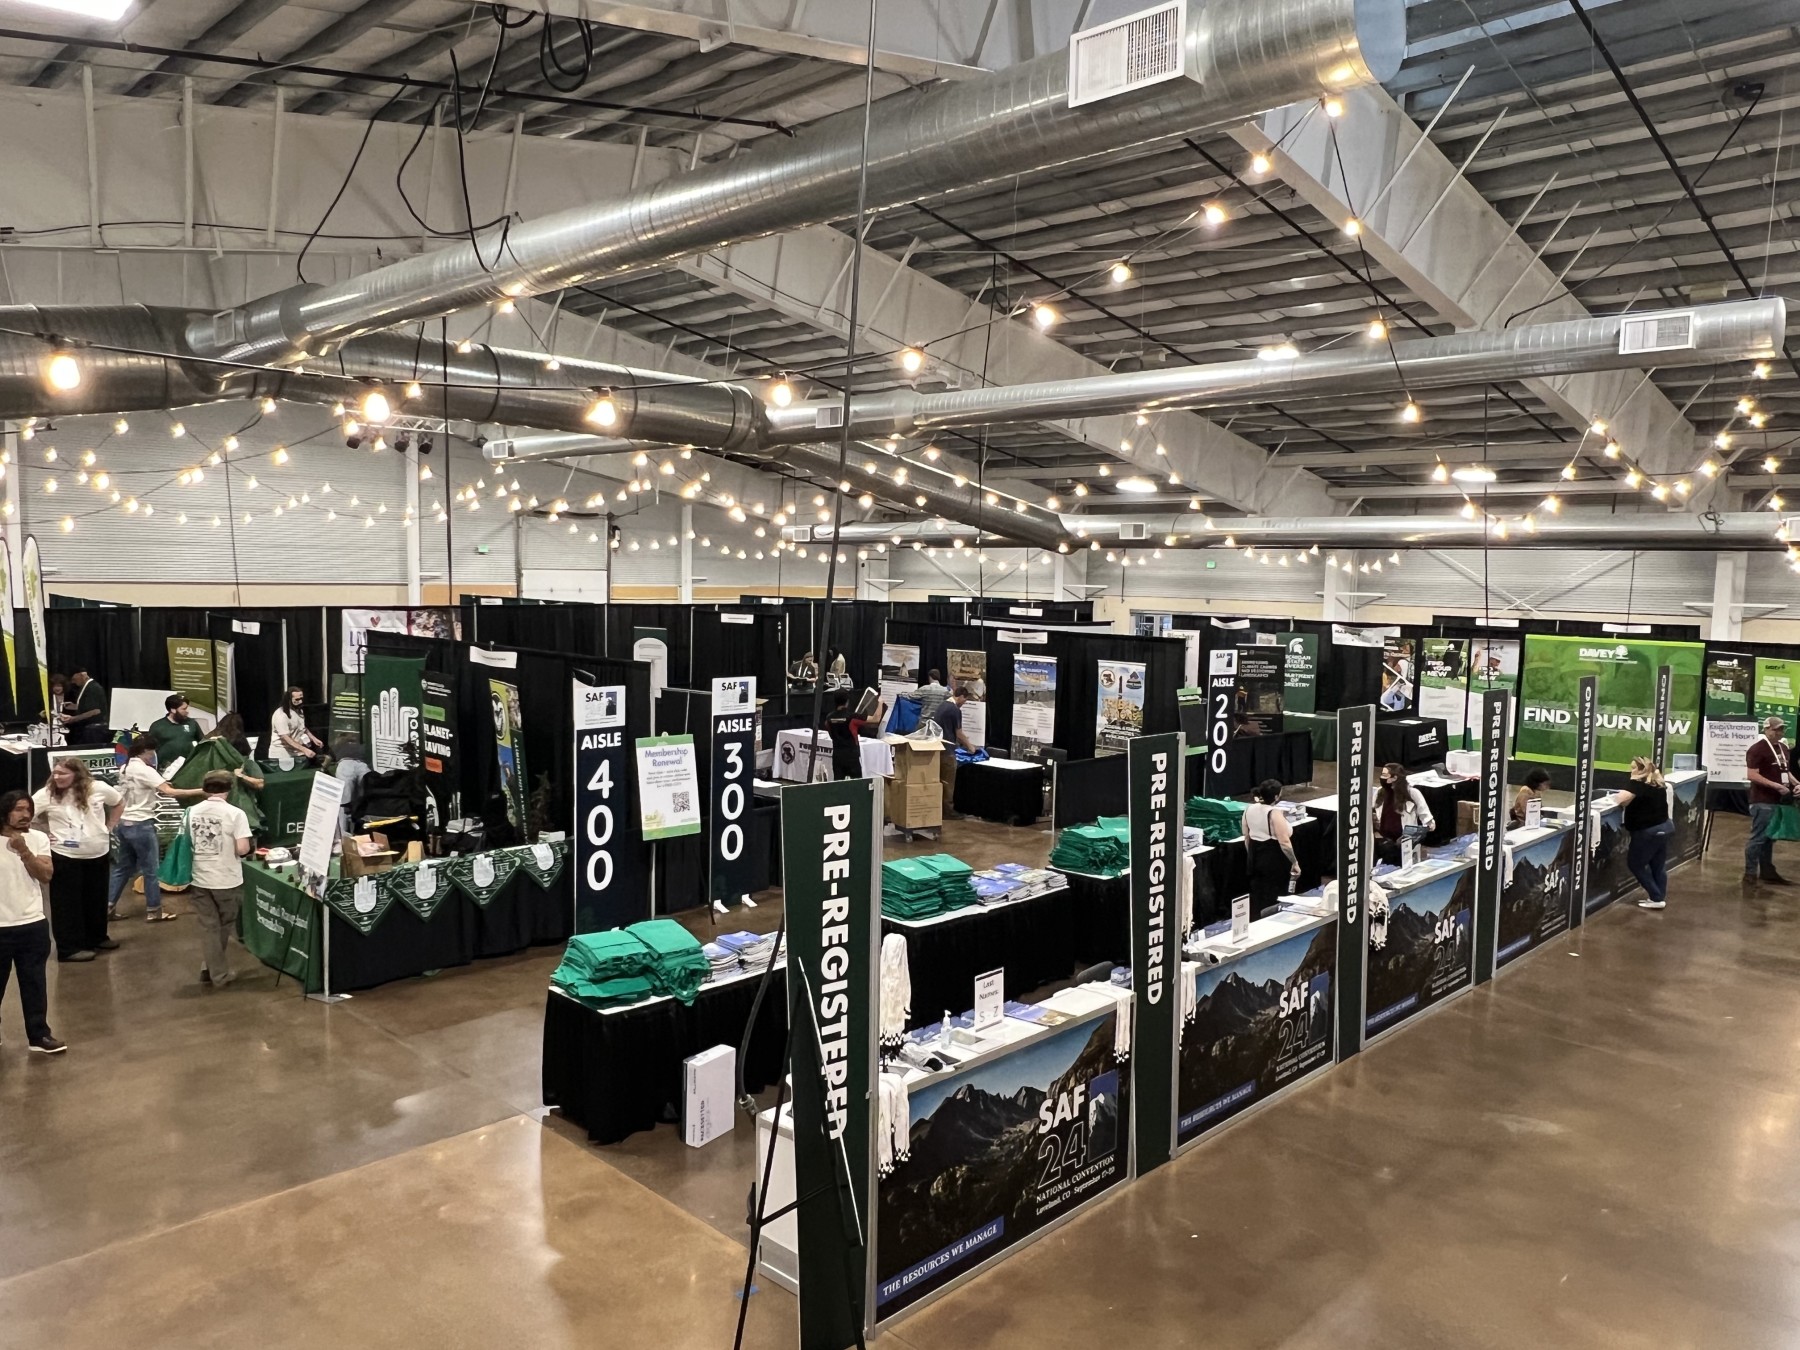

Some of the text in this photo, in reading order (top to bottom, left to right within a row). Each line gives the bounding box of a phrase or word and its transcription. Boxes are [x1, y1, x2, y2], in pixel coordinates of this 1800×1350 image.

[1580, 648, 1615, 658] DAVEY
[722, 682, 737, 690] SAF
[1212, 678, 1234, 687] AISLE
[585, 692, 604, 702] SAF
[716, 718, 752, 734] AISLE
[1524, 707, 1570, 724] FIND
[1709, 722, 1756, 732] Registration
[581, 732, 622, 750] AISLE
[1212, 694, 1228, 773] 200
[1710, 731, 1755, 740] Desk Hours
[645, 748, 688, 758] Membership
[652, 758, 682, 766] Renewal
[1485, 702, 1502, 871] PRE-REGISTERED
[1574, 686, 1592, 890] ONSITE REGISTRATION
[720, 742, 744, 860] 300
[586, 759, 614, 890] 400
[1346, 720, 1362, 924] PRE-REGISTERED
[1148, 752, 1168, 1005] PRE-REGISTERED
[1544, 869, 1560, 893] SAF
[1434, 915, 1456, 944] SAF
[821, 804, 851, 1140] PRE-REGISTERED
[984, 980, 994, 988] Last
[979, 990, 999, 1000] Names
[1279, 982, 1309, 1018] SAF
[980, 1010, 986, 1022] S
[994, 1006, 999, 1018] Z
[1278, 1011, 1309, 1062] 24
[1039, 1084, 1086, 1134] SAF
[1038, 1121, 1086, 1190] 24
[1036, 1154, 1114, 1203] NATIONAL CONVENTION
[1074, 1175, 1100, 1193] September
[882, 1224, 997, 1296] THE RESOURCES WE MANAGE
